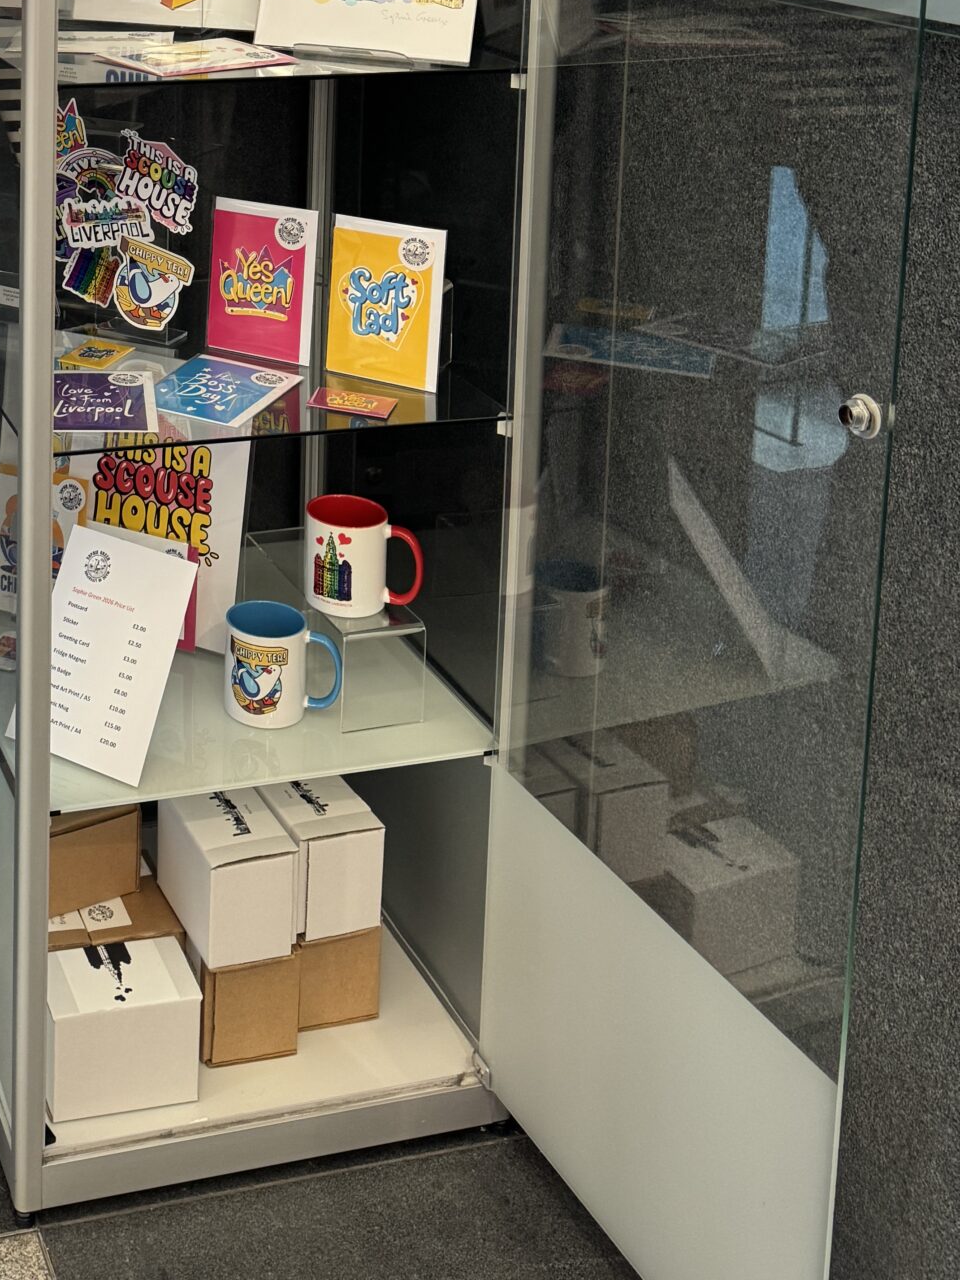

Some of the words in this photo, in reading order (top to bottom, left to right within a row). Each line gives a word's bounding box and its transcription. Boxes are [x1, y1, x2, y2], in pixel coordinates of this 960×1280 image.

[131, 136, 164, 165] THIS
[167, 157, 182, 175] IS
[184, 167, 196, 183] A
[124, 150, 196, 200] SCOUSE
[119, 167, 193, 227] HOUSE
[70, 222, 150, 243] LIVERPOOL
[129, 244, 164, 267] CHIPPY
[166, 261, 189, 277] TEA!
[235, 248, 274, 283] Yes
[219, 270, 294, 308] Queen!
[349, 266, 412, 309] Soft
[352, 299, 400, 336] Lad
[61, 384, 94, 397] Love
[181, 372, 237, 394] Boss
[176, 383, 238, 405] Day!
[53, 399, 135, 422] Liverpool
[162, 436, 188, 472] IS
[191, 446, 212, 478] A
[93, 455, 213, 514] SCOUSE
[93, 489, 212, 557] HOUSE
[0, 574, 17, 593] CHI
[68, 601, 88, 612] Postcard
[72, 586, 87, 596] Sophie
[88, 592, 101, 601] Green
[114, 601, 126, 610] Price
[126, 604, 135, 613] List
[62, 616, 79, 626] Sticker
[58, 632, 78, 645] Greeting
[78, 639, 90, 648] Card
[128, 639, 142, 649] £2.50
[53, 647, 68, 658] Fridge
[68, 653, 87, 665] Magnet
[235, 644, 264, 662] CHIPPY
[266, 651, 288, 663] TEA!
[56, 666, 71, 677] Badge
[118, 671, 133, 681] £5.00
[60, 686, 68, 694] Art
[68, 688, 80, 698] Print
[84, 693, 91, 702] A5
[58, 703, 69, 713] Mug
[108, 704, 126, 715] £10.00
[58, 721, 71, 730] Print
[104, 720, 122, 732] £15.00
[99, 737, 117, 748] £20.00
